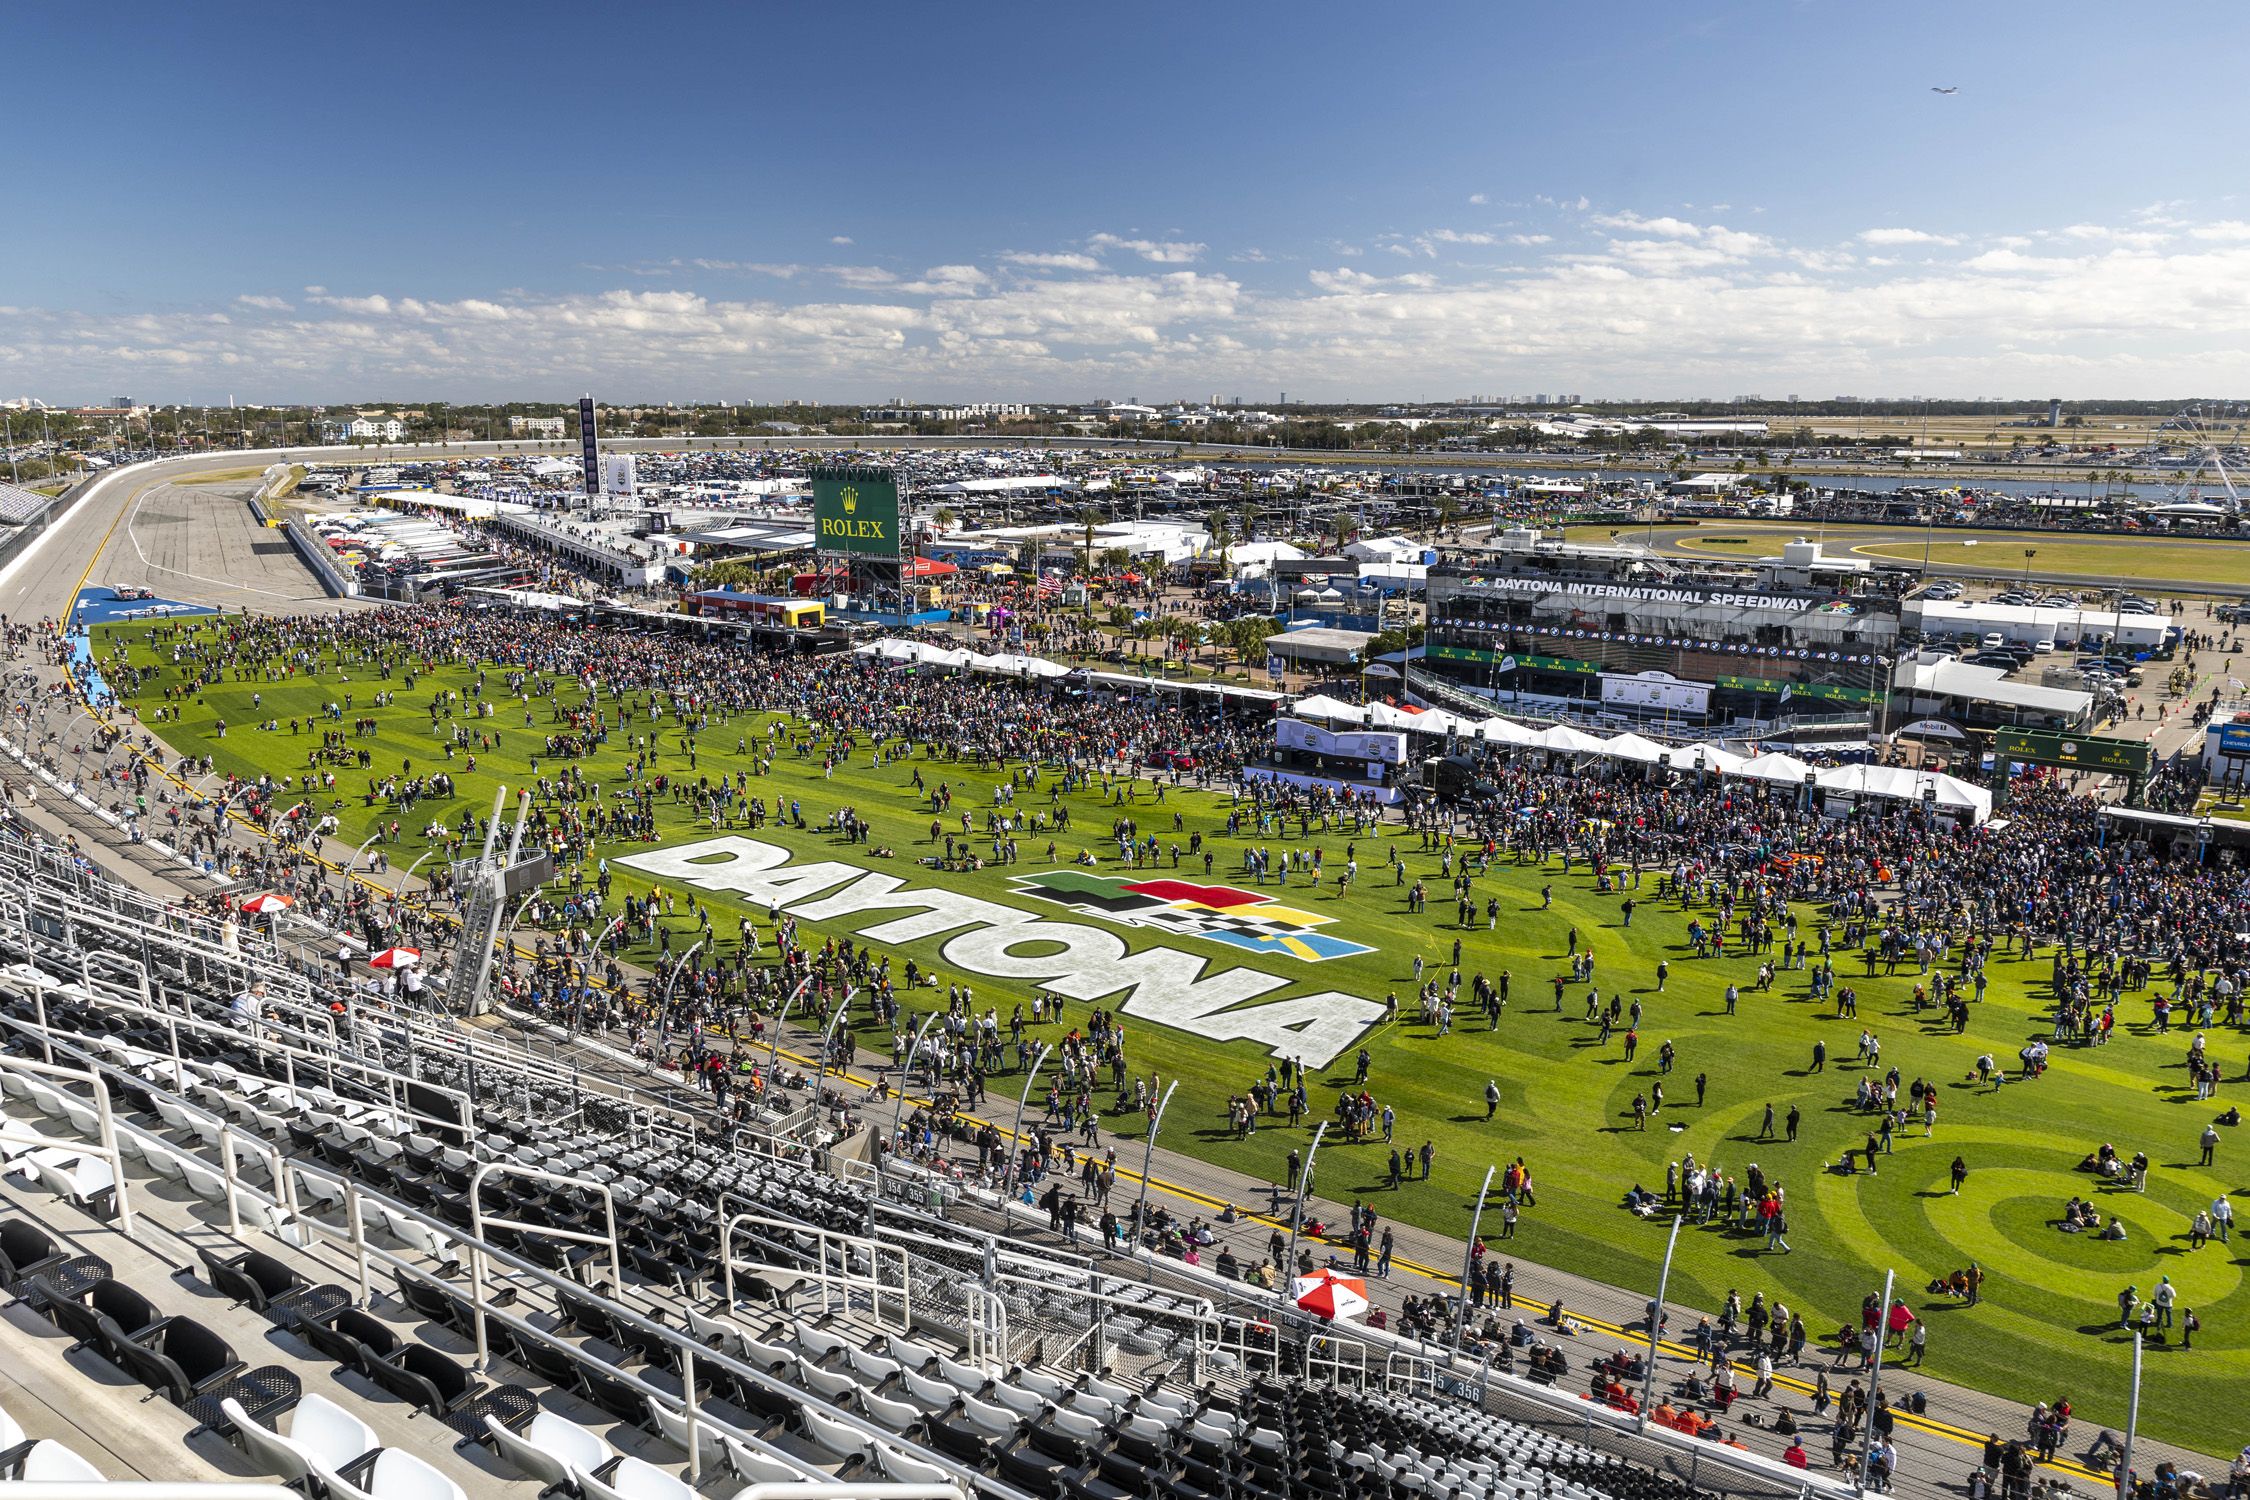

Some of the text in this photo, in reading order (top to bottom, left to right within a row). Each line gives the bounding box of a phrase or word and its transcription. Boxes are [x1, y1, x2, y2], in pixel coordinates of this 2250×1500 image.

[822, 518, 885, 538] ROLEX
[1494, 578, 1812, 611] DAYTONA INTERNATIONAL SPEEDWAY
[1723, 682, 1744, 690] ROLEX
[1860, 696, 1884, 704] ROLEX
[1920, 722, 1940, 730] Mobil
[2009, 745, 2036, 754] ROLEX
[2223, 740, 2250, 748] CHEVROL
[2102, 756, 2130, 765] ROLEX
[610, 834, 1389, 1070] DAYTONA
[886, 1180, 924, 1203] 354 355
[1423, 1369, 1480, 1402] 355 356
